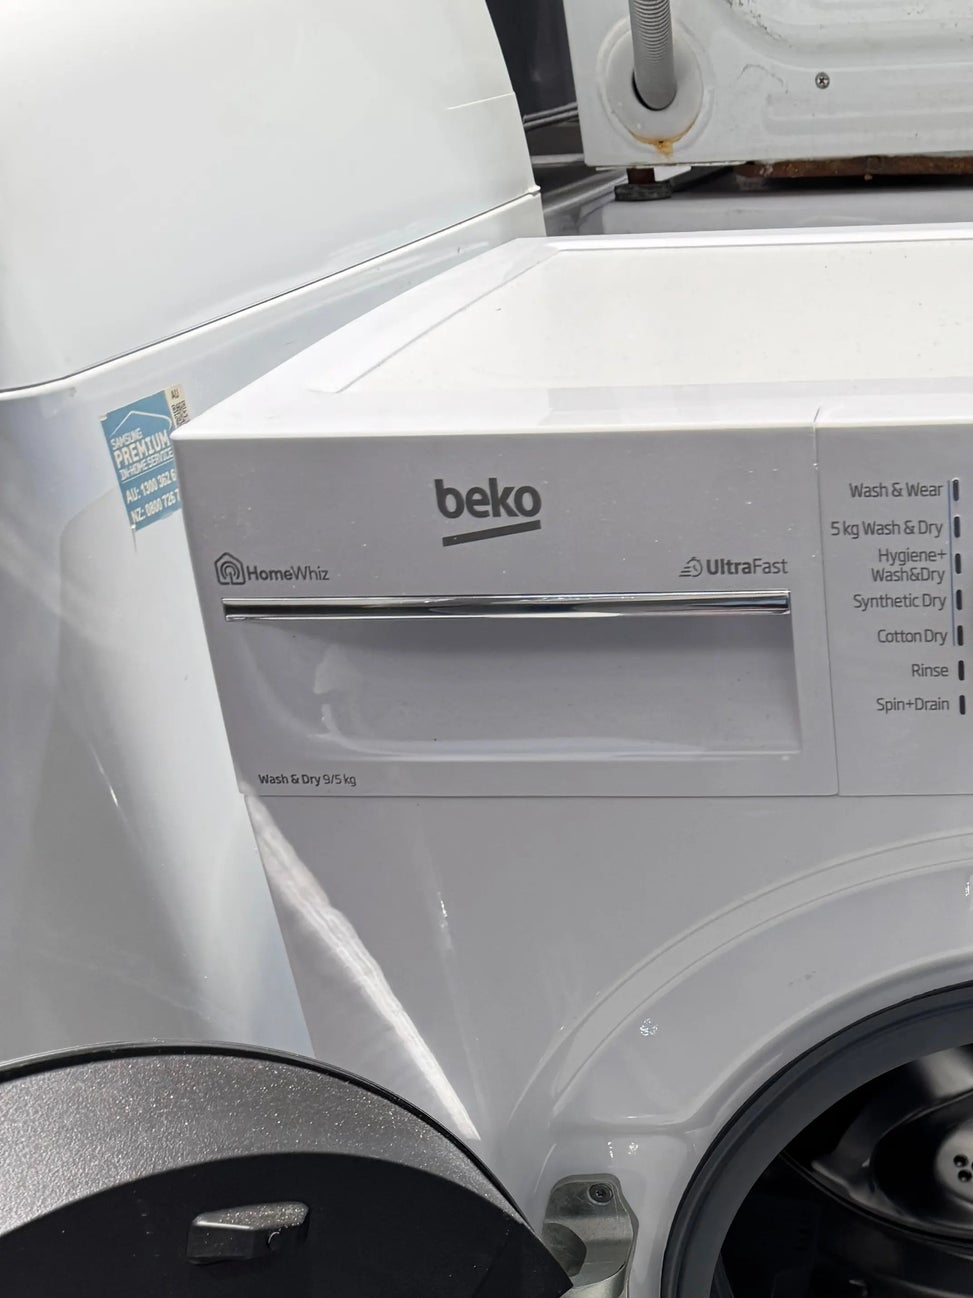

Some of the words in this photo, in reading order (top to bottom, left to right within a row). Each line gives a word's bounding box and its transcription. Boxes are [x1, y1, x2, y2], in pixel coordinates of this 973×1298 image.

[114, 430, 171, 468] PREMIUM
[434, 477, 542, 519] beko
[848, 482, 889, 498] Wash
[891, 482, 904, 497] &
[905, 482, 944, 497] Wear
[830, 521, 840, 536] 5
[842, 520, 860, 540] kg
[862, 520, 900, 536] Wash
[904, 520, 916, 535] &
[918, 520, 944, 538] Dry
[878, 547, 948, 566] Hygiene+
[247, 564, 330, 582] HomeWhiz
[706, 558, 790, 576] UltraFast
[871, 566, 946, 585] Wash&Dry
[852, 593, 920, 612] Synthetic
[922, 593, 947, 611] Dry
[877, 628, 922, 644] Cotton
[924, 628, 948, 646] Dry
[911, 663, 950, 678] Rinse
[876, 696, 950, 714] Spin+Drain
[258, 774, 289, 784] Wash
[290, 774, 300, 785] &
[301, 774, 321, 787] Dry
[322, 774, 342, 785] 9/5
[344, 773, 358, 787] kg
